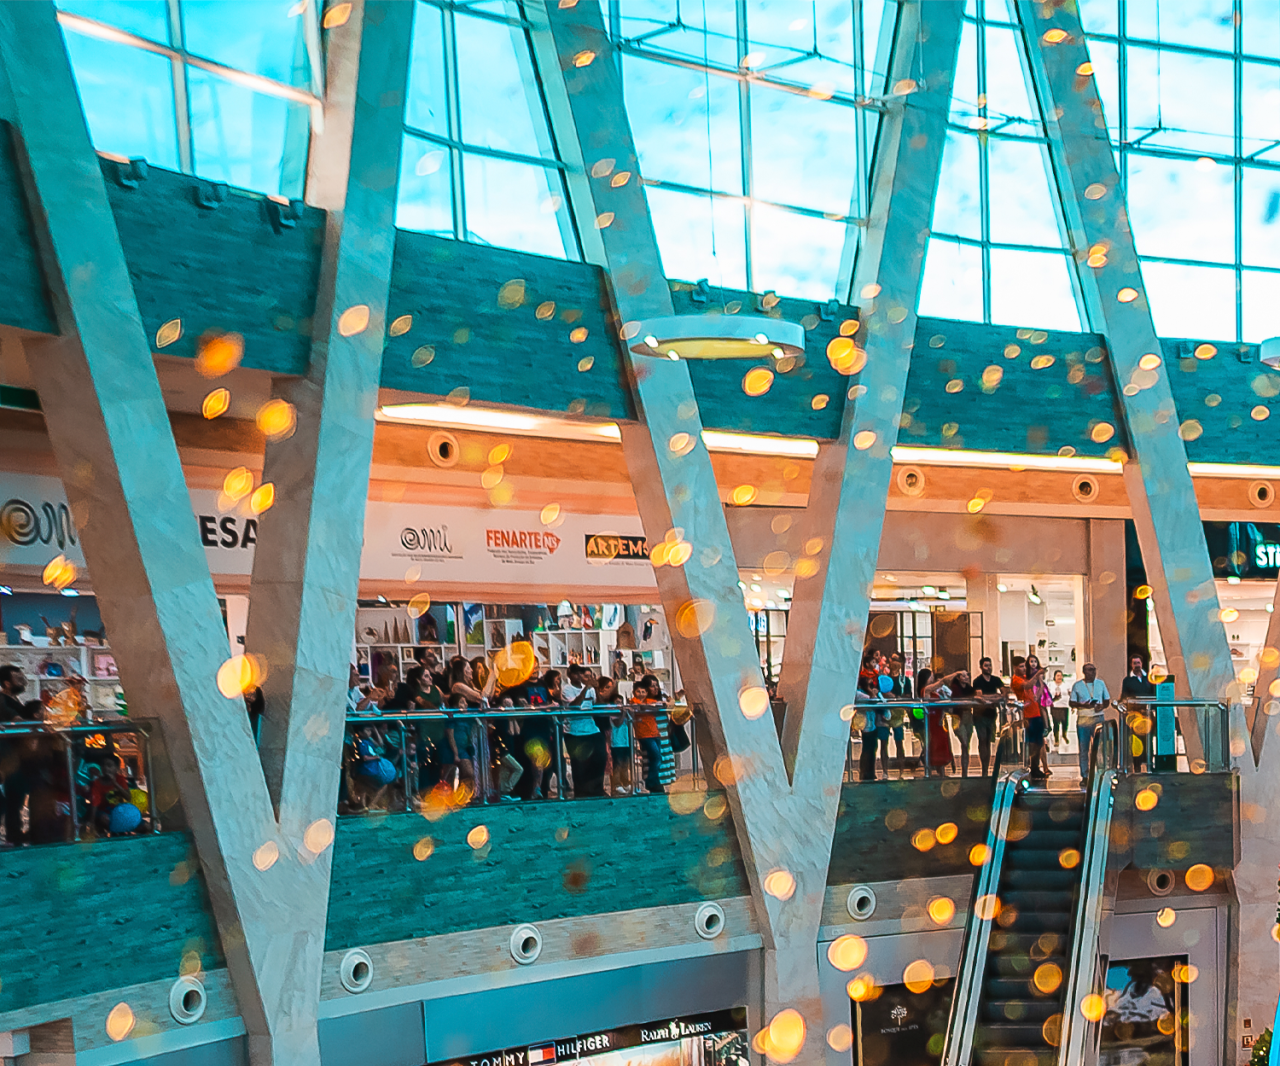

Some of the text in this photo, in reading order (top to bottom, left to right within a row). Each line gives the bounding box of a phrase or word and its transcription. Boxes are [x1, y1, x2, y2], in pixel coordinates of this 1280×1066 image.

[486, 529, 541, 549] FENARTE
[640, 1021, 712, 1042] RALPH LAUREN
[557, 1034, 610, 1056] HILFIGER
